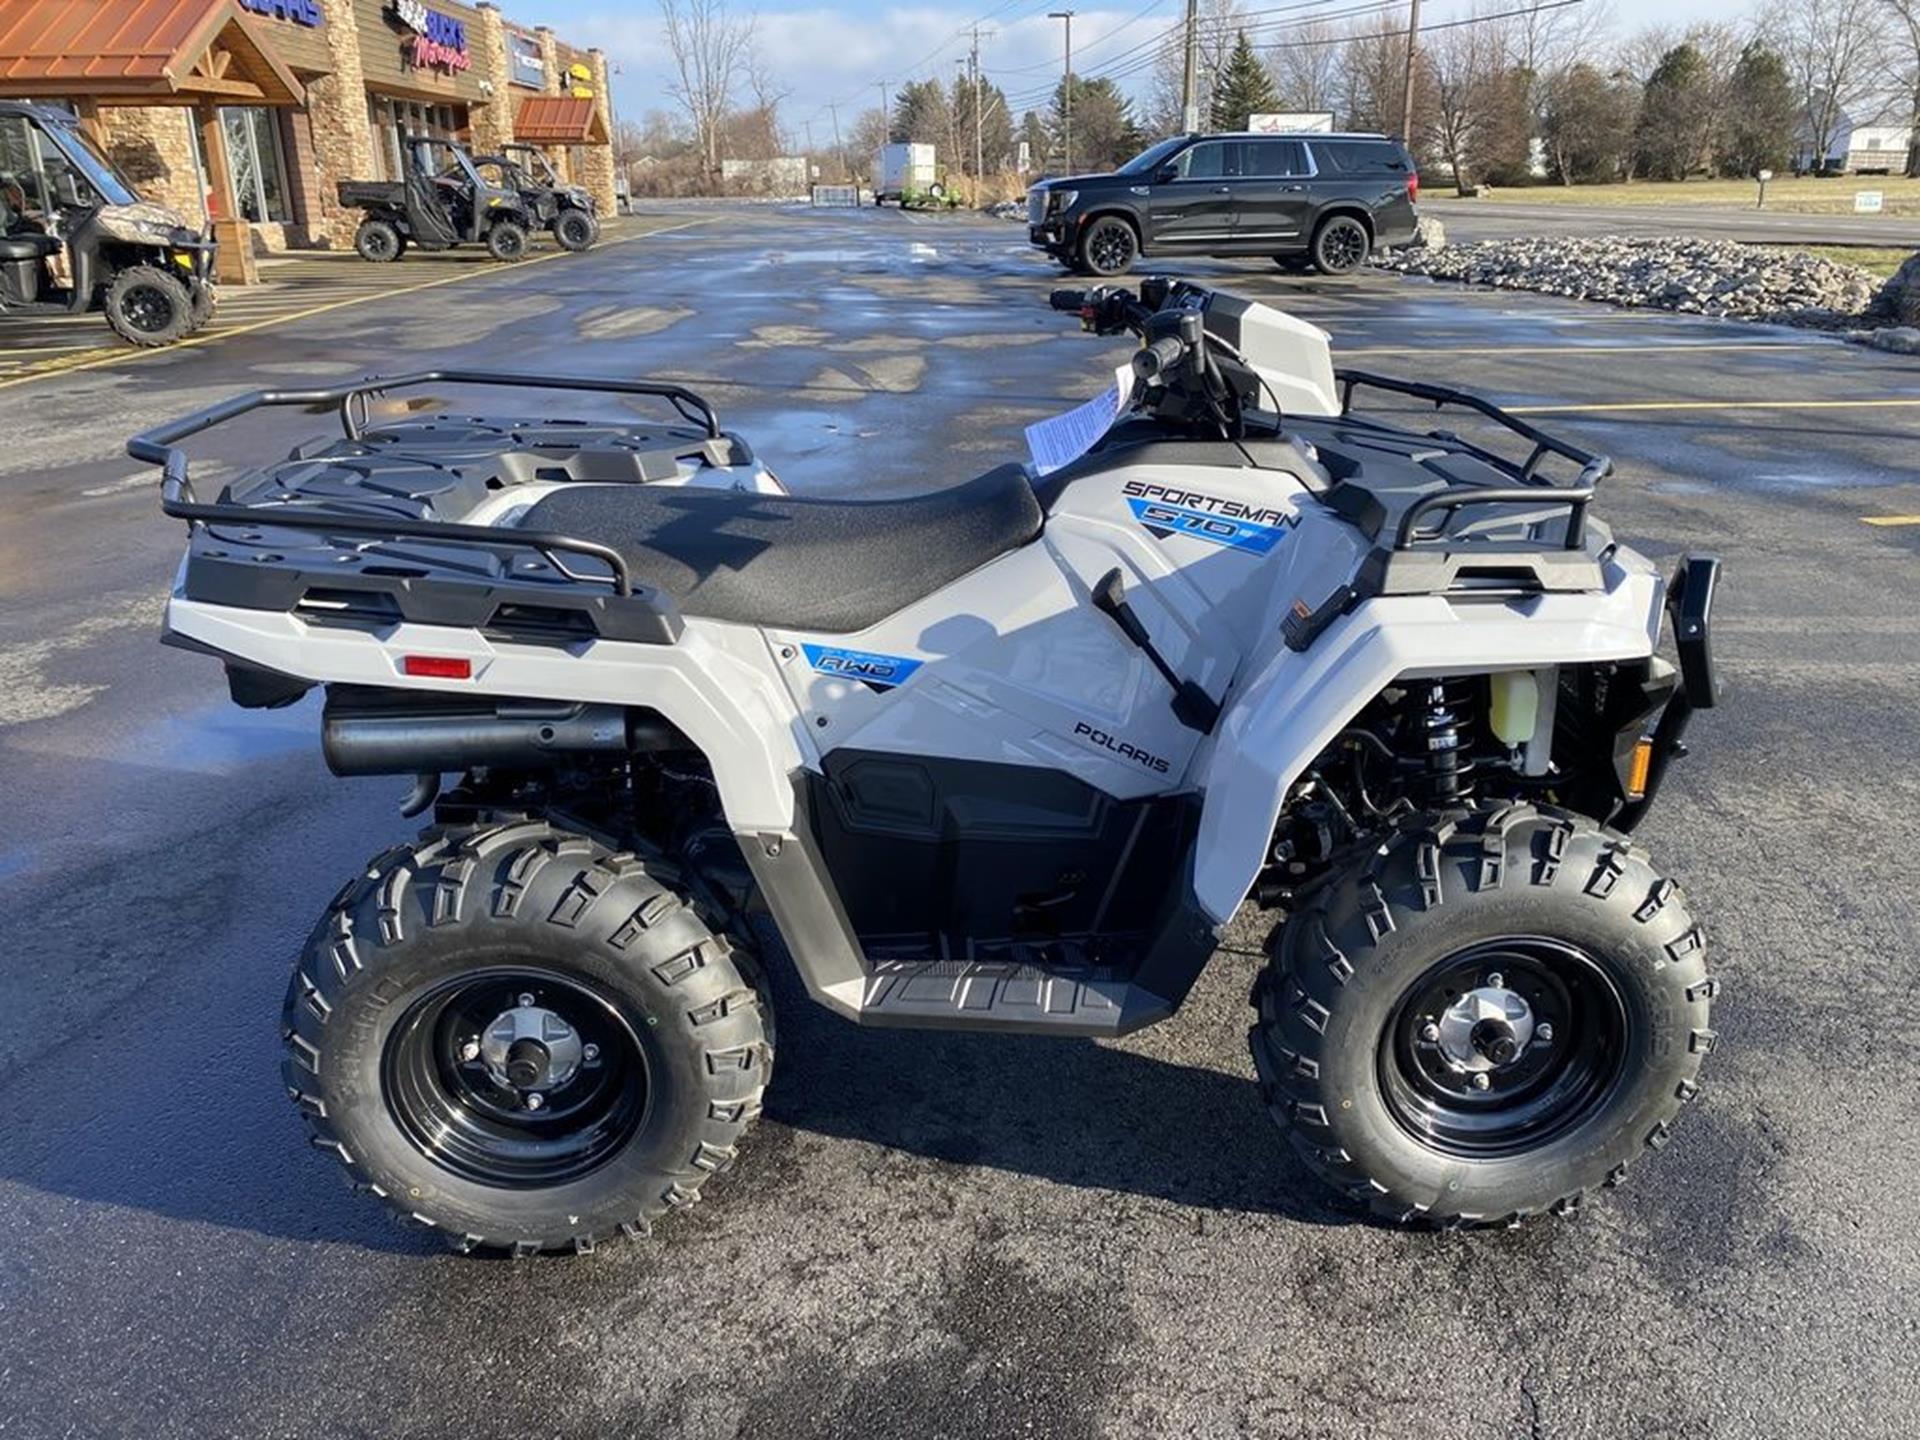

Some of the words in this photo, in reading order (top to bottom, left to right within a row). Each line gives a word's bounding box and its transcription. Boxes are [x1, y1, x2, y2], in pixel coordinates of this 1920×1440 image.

[1122, 480, 1304, 530] SPORTSMAN
[1142, 506, 1238, 537] 570
[817, 655, 897, 678] AWD
[1074, 721, 1171, 774] POLARIS
